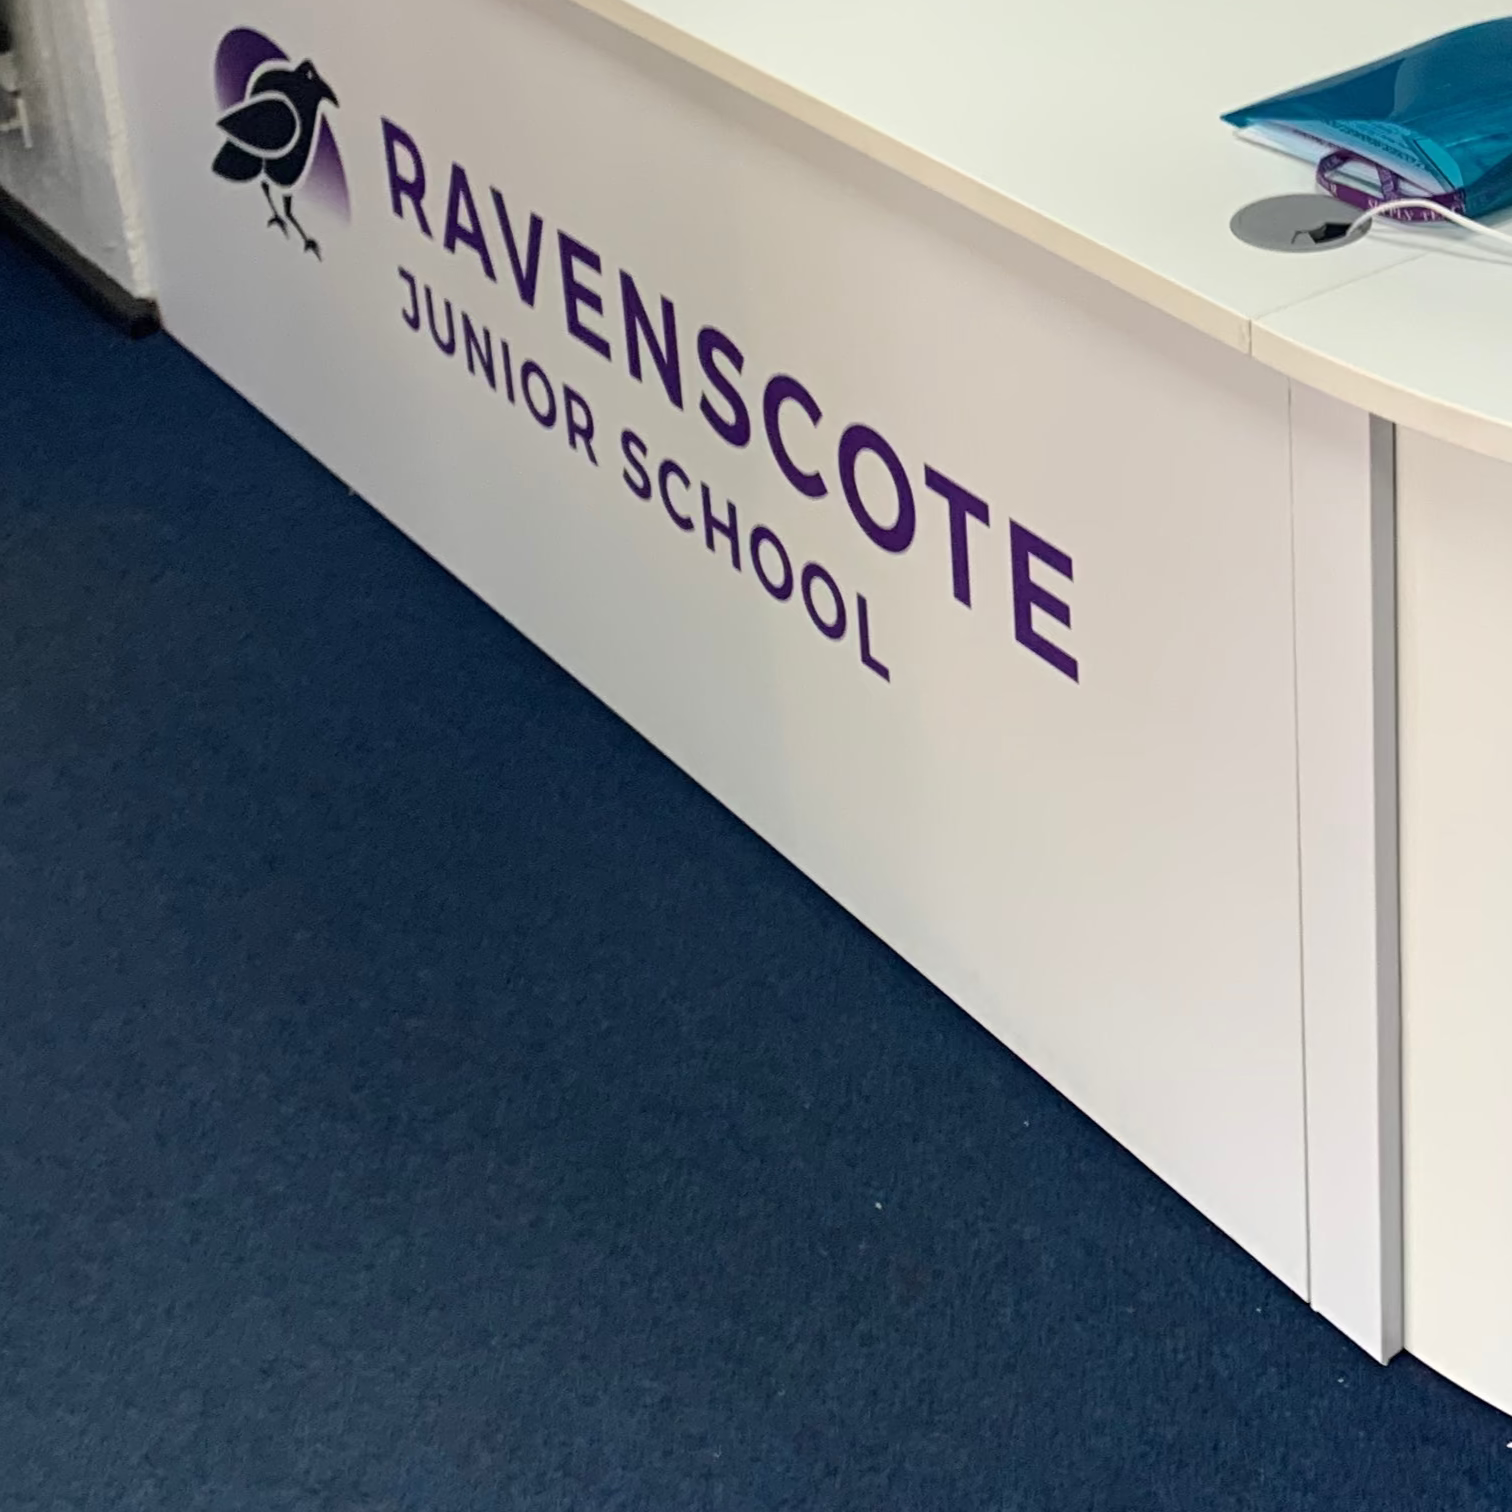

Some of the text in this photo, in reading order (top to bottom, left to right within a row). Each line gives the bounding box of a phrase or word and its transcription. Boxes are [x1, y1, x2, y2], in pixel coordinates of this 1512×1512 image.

[379, 115, 1079, 685] RAVENSCOTE
[397, 265, 891, 684] JUNIOR SCHOOL
